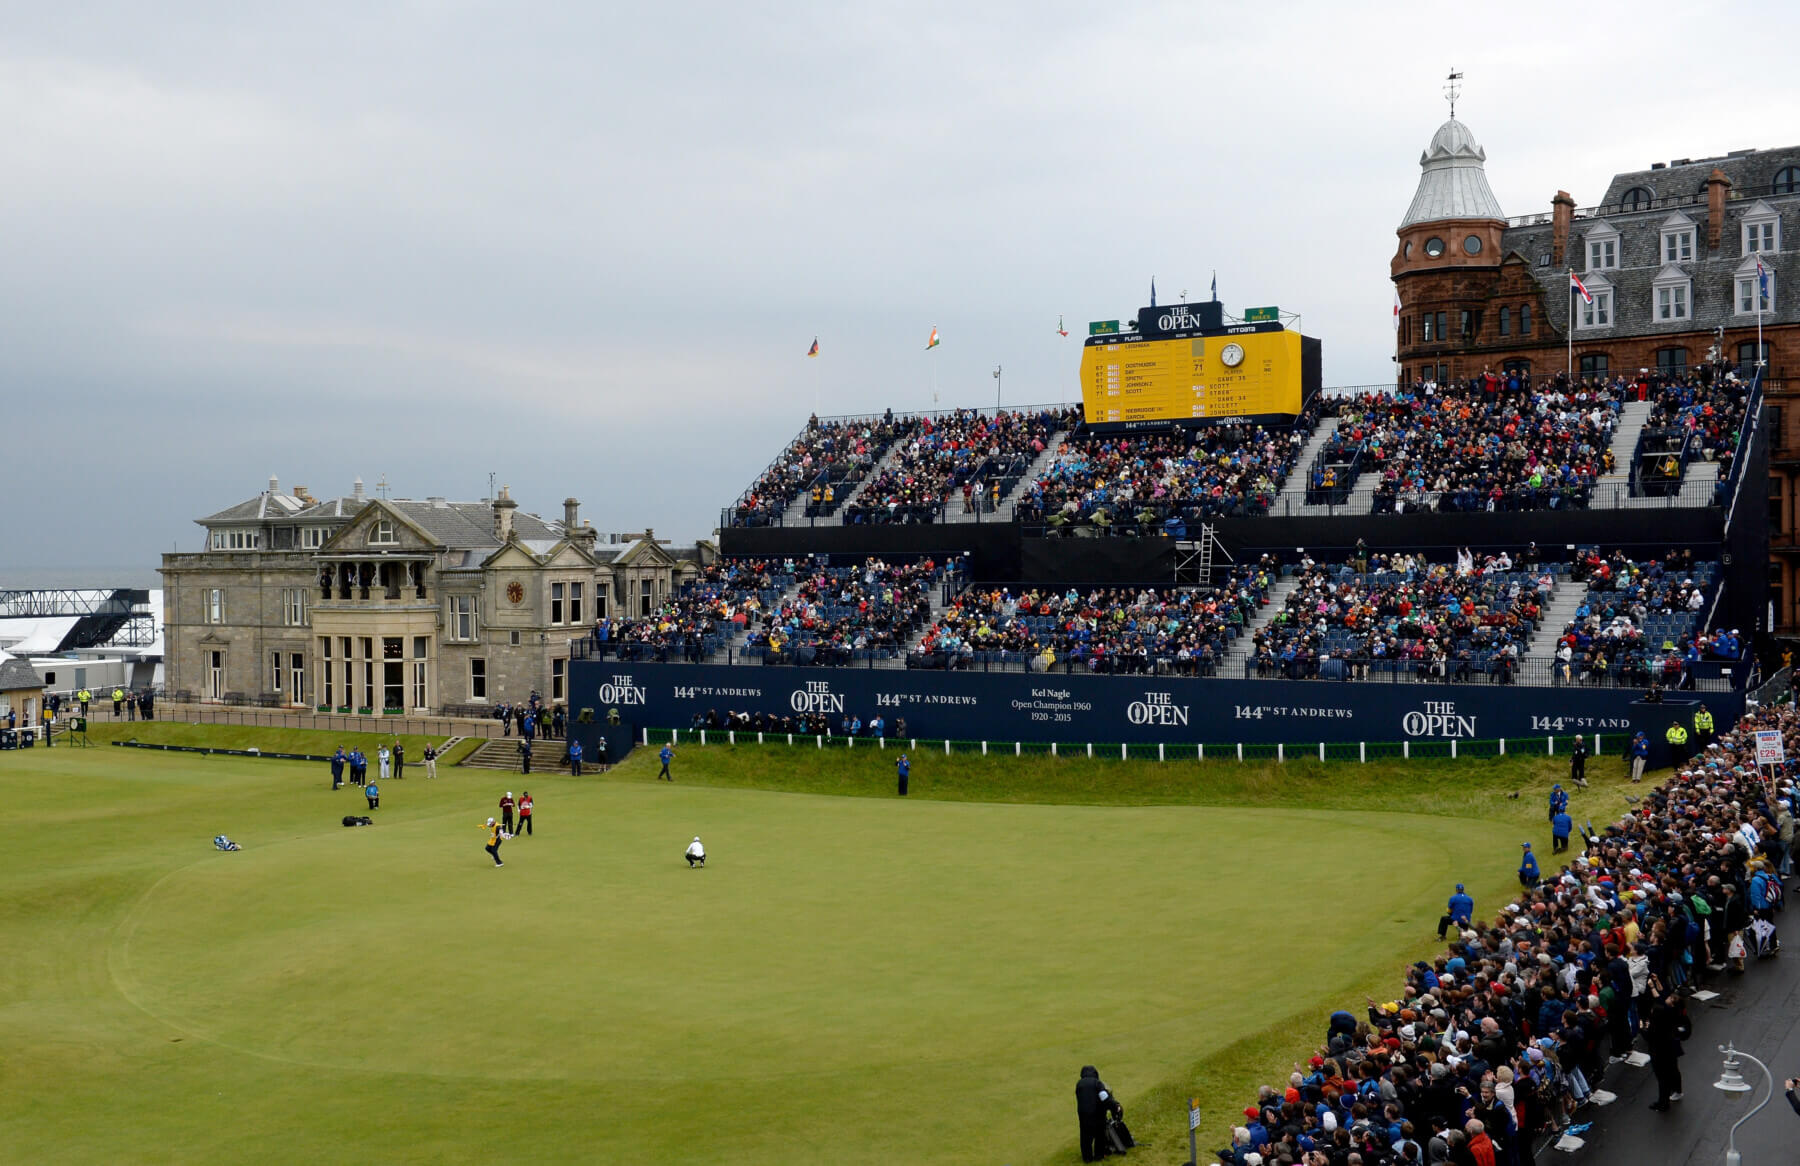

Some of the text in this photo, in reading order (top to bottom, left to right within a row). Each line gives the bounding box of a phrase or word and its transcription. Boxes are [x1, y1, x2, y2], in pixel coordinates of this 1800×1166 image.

[1170, 306, 1189, 316] THE
[1158, 314, 1200, 330] OPEN
[612, 675, 632, 686] THE
[715, 688, 761, 696] ANDREWS
[806, 681, 829, 693] THE
[600, 683, 646, 704] OPEN
[1031, 689, 1070, 700] Kel Nagle
[1144, 692, 1171, 704] THE
[791, 690, 844, 713] OPEN
[925, 696, 977, 705] ANDREWS
[1012, 700, 1091, 712] Open Champion 1960
[1128, 701, 1189, 726] OPEN
[1235, 706, 1353, 719] 144TH ST ANDREWS
[1424, 701, 1455, 714] THE
[1031, 712, 1048, 720] 1920
[1054, 713, 1071, 722] 2015
[1531, 716, 1630, 730] 144TH ST AND
[1402, 711, 1476, 737] OPEN
